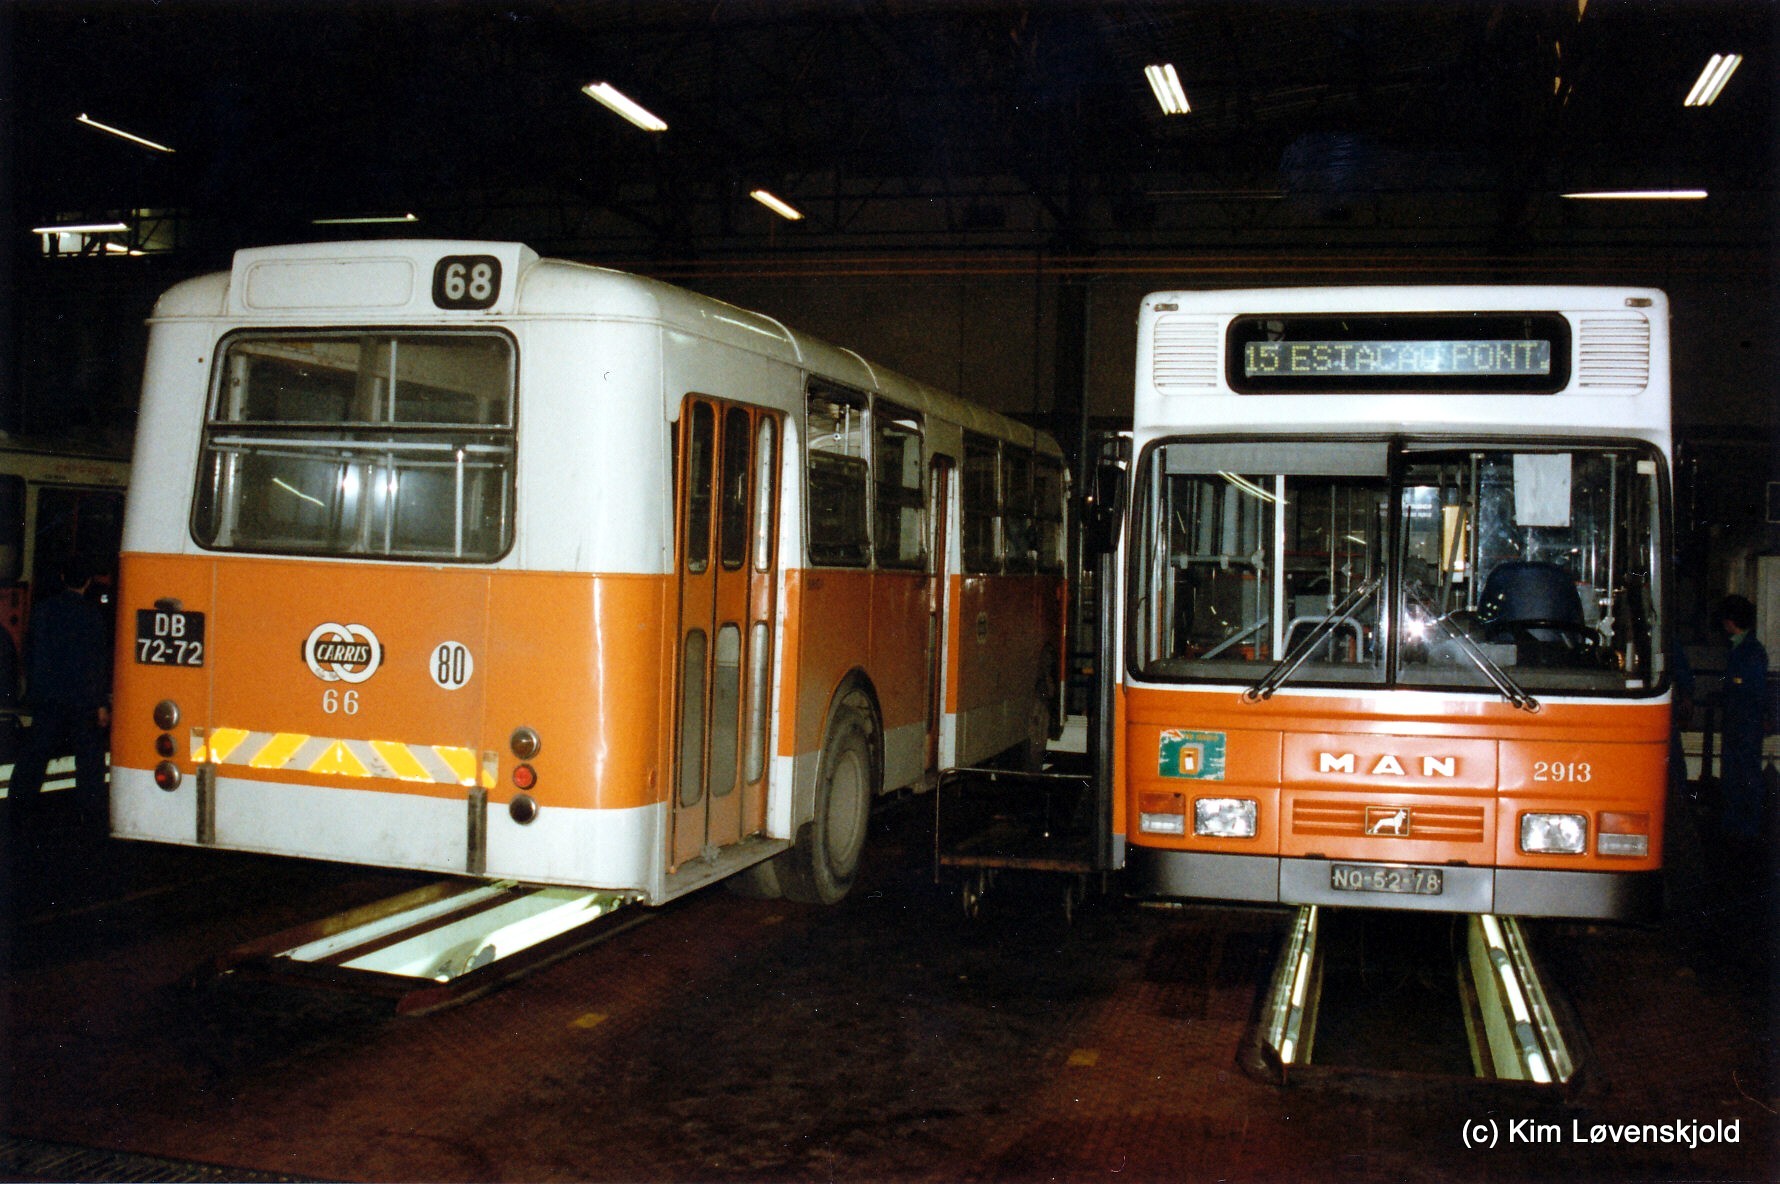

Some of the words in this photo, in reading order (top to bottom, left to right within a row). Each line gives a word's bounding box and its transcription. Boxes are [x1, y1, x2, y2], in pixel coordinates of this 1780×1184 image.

[445, 263, 492, 300] 68
[1247, 345, 1279, 371] 15
[155, 613, 186, 637] DB
[137, 638, 203, 665] 72-72
[316, 643, 369, 663] CARRIS
[438, 645, 466, 685] 80
[322, 688, 360, 715] 66
[1320, 752, 1455, 777] MAN
[1533, 761, 1592, 783] 2913
